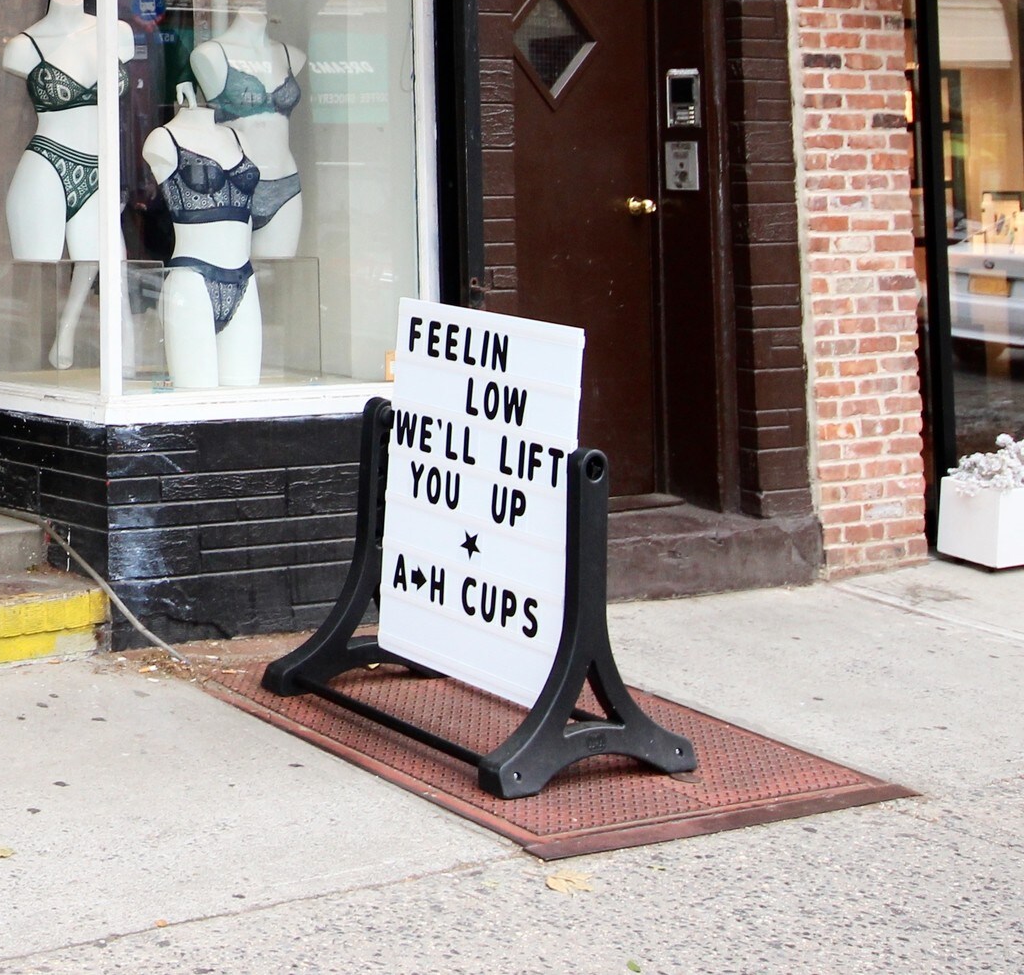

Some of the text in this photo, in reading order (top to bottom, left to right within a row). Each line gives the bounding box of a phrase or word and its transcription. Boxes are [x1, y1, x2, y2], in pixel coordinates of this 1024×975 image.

[408, 316, 509, 373] FEELIN
[465, 377, 528, 427] LOW
[396, 409, 564, 488] WE'LL LIFT
[410, 461, 527, 527] YOU UP
[462, 576, 539, 638] CUPS
